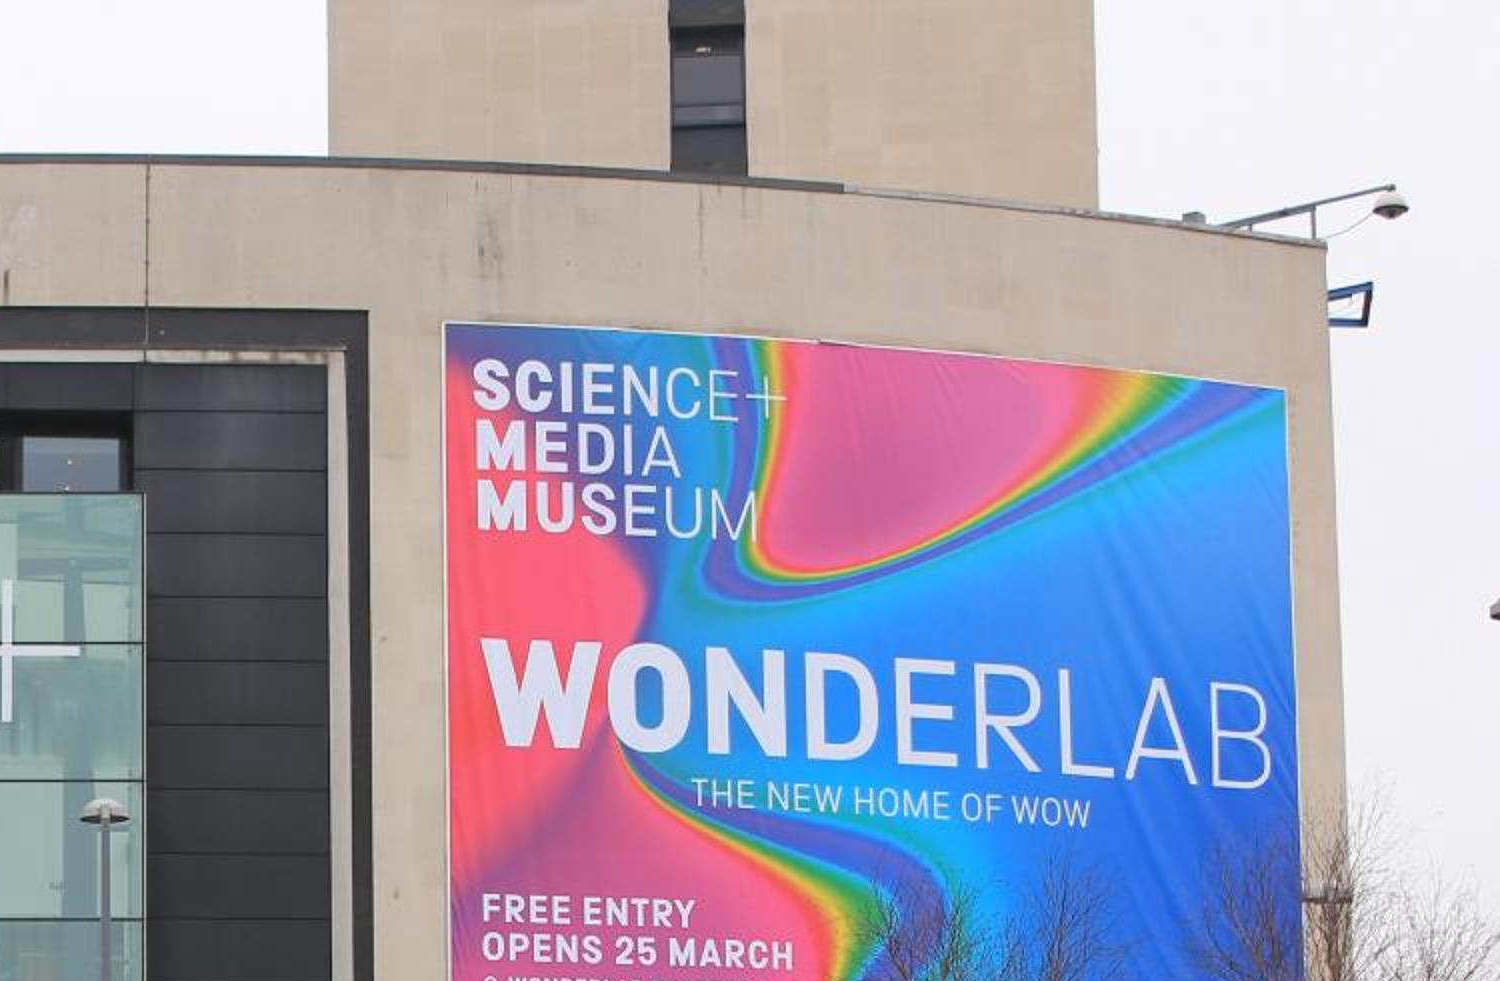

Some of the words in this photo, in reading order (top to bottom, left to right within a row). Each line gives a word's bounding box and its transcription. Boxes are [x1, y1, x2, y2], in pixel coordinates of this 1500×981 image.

[476, 419, 681, 478] MEDIA
[477, 479, 757, 542] MUSEUM
[480, 637, 1273, 790] WONDERLAB
[691, 779, 755, 809] THE
[766, 780, 843, 814] NEW
[854, 787, 951, 820] HOME
[961, 793, 1003, 823] OF
[1011, 795, 1091, 828] WOW
[482, 893, 571, 925] FREE
[583, 896, 696, 928] ENTRY
[482, 931, 603, 965] OPENS
[615, 935, 658, 965] 25
[669, 937, 794, 971] MARCH
